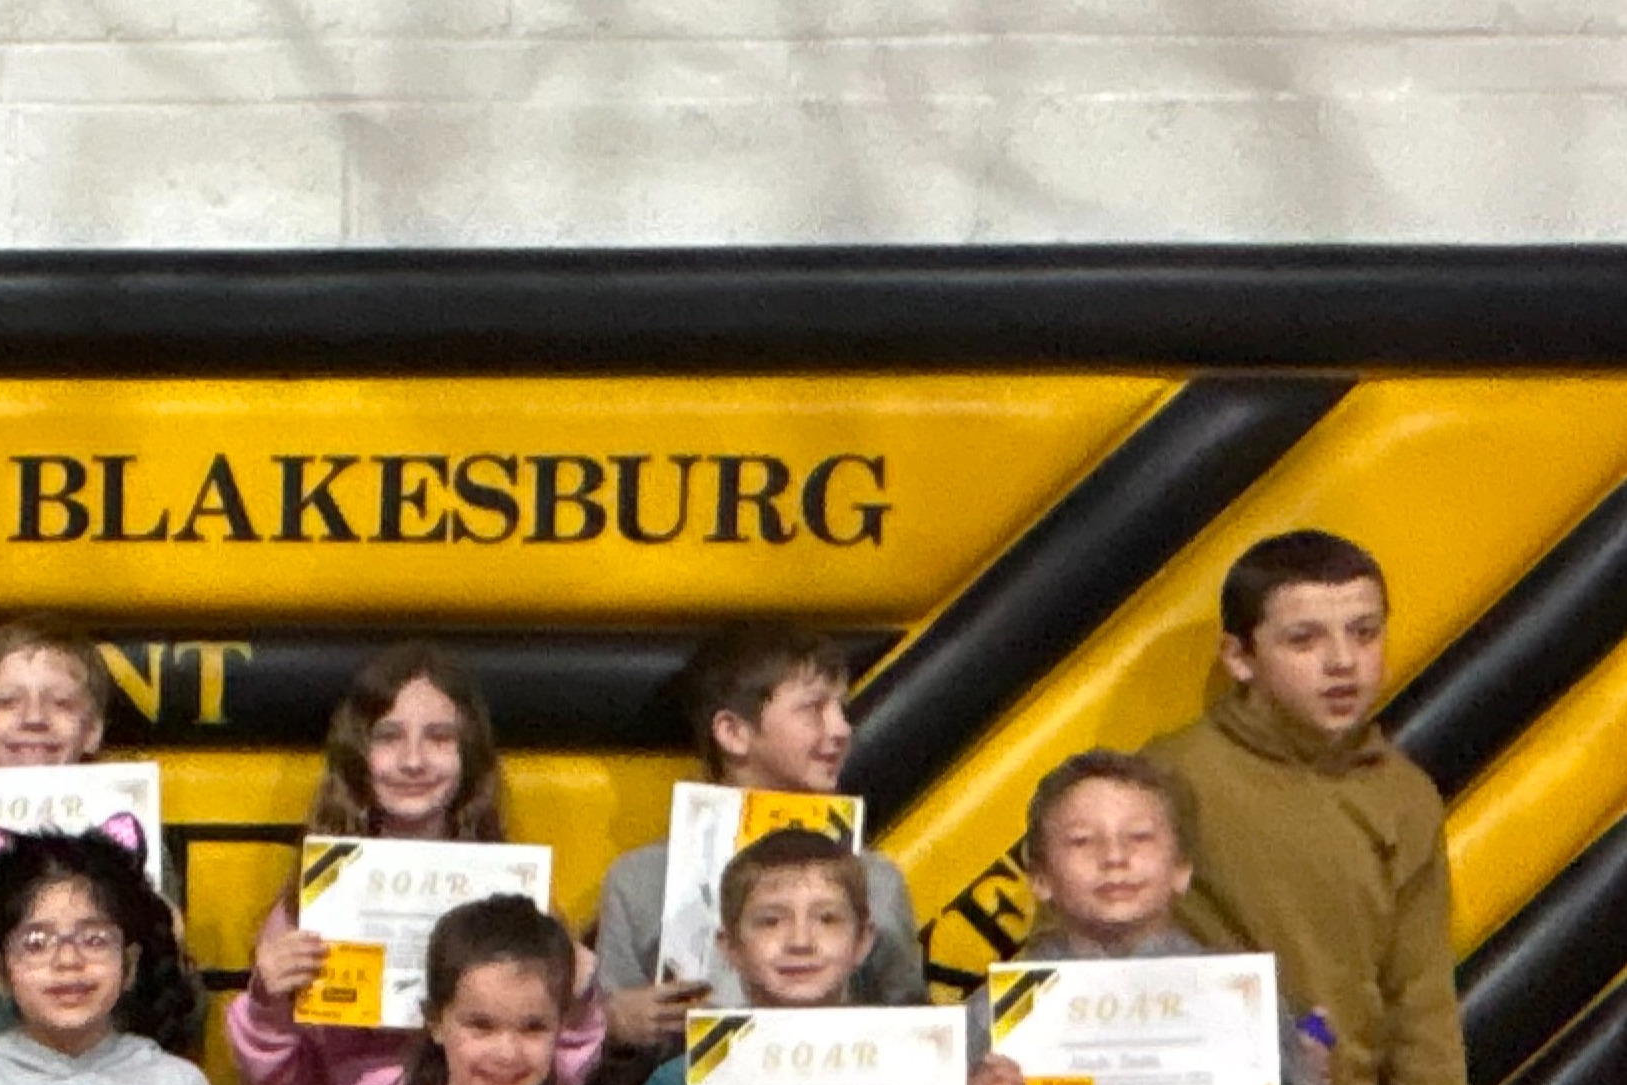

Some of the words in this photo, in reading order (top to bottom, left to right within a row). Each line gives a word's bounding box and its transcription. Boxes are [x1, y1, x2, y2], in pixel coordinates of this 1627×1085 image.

[8, 452, 891, 548] BLAKESBURG
[368, 868, 470, 896] SOAR
[1068, 989, 1185, 1023] SOAR
[761, 1040, 879, 1072] SOAR
